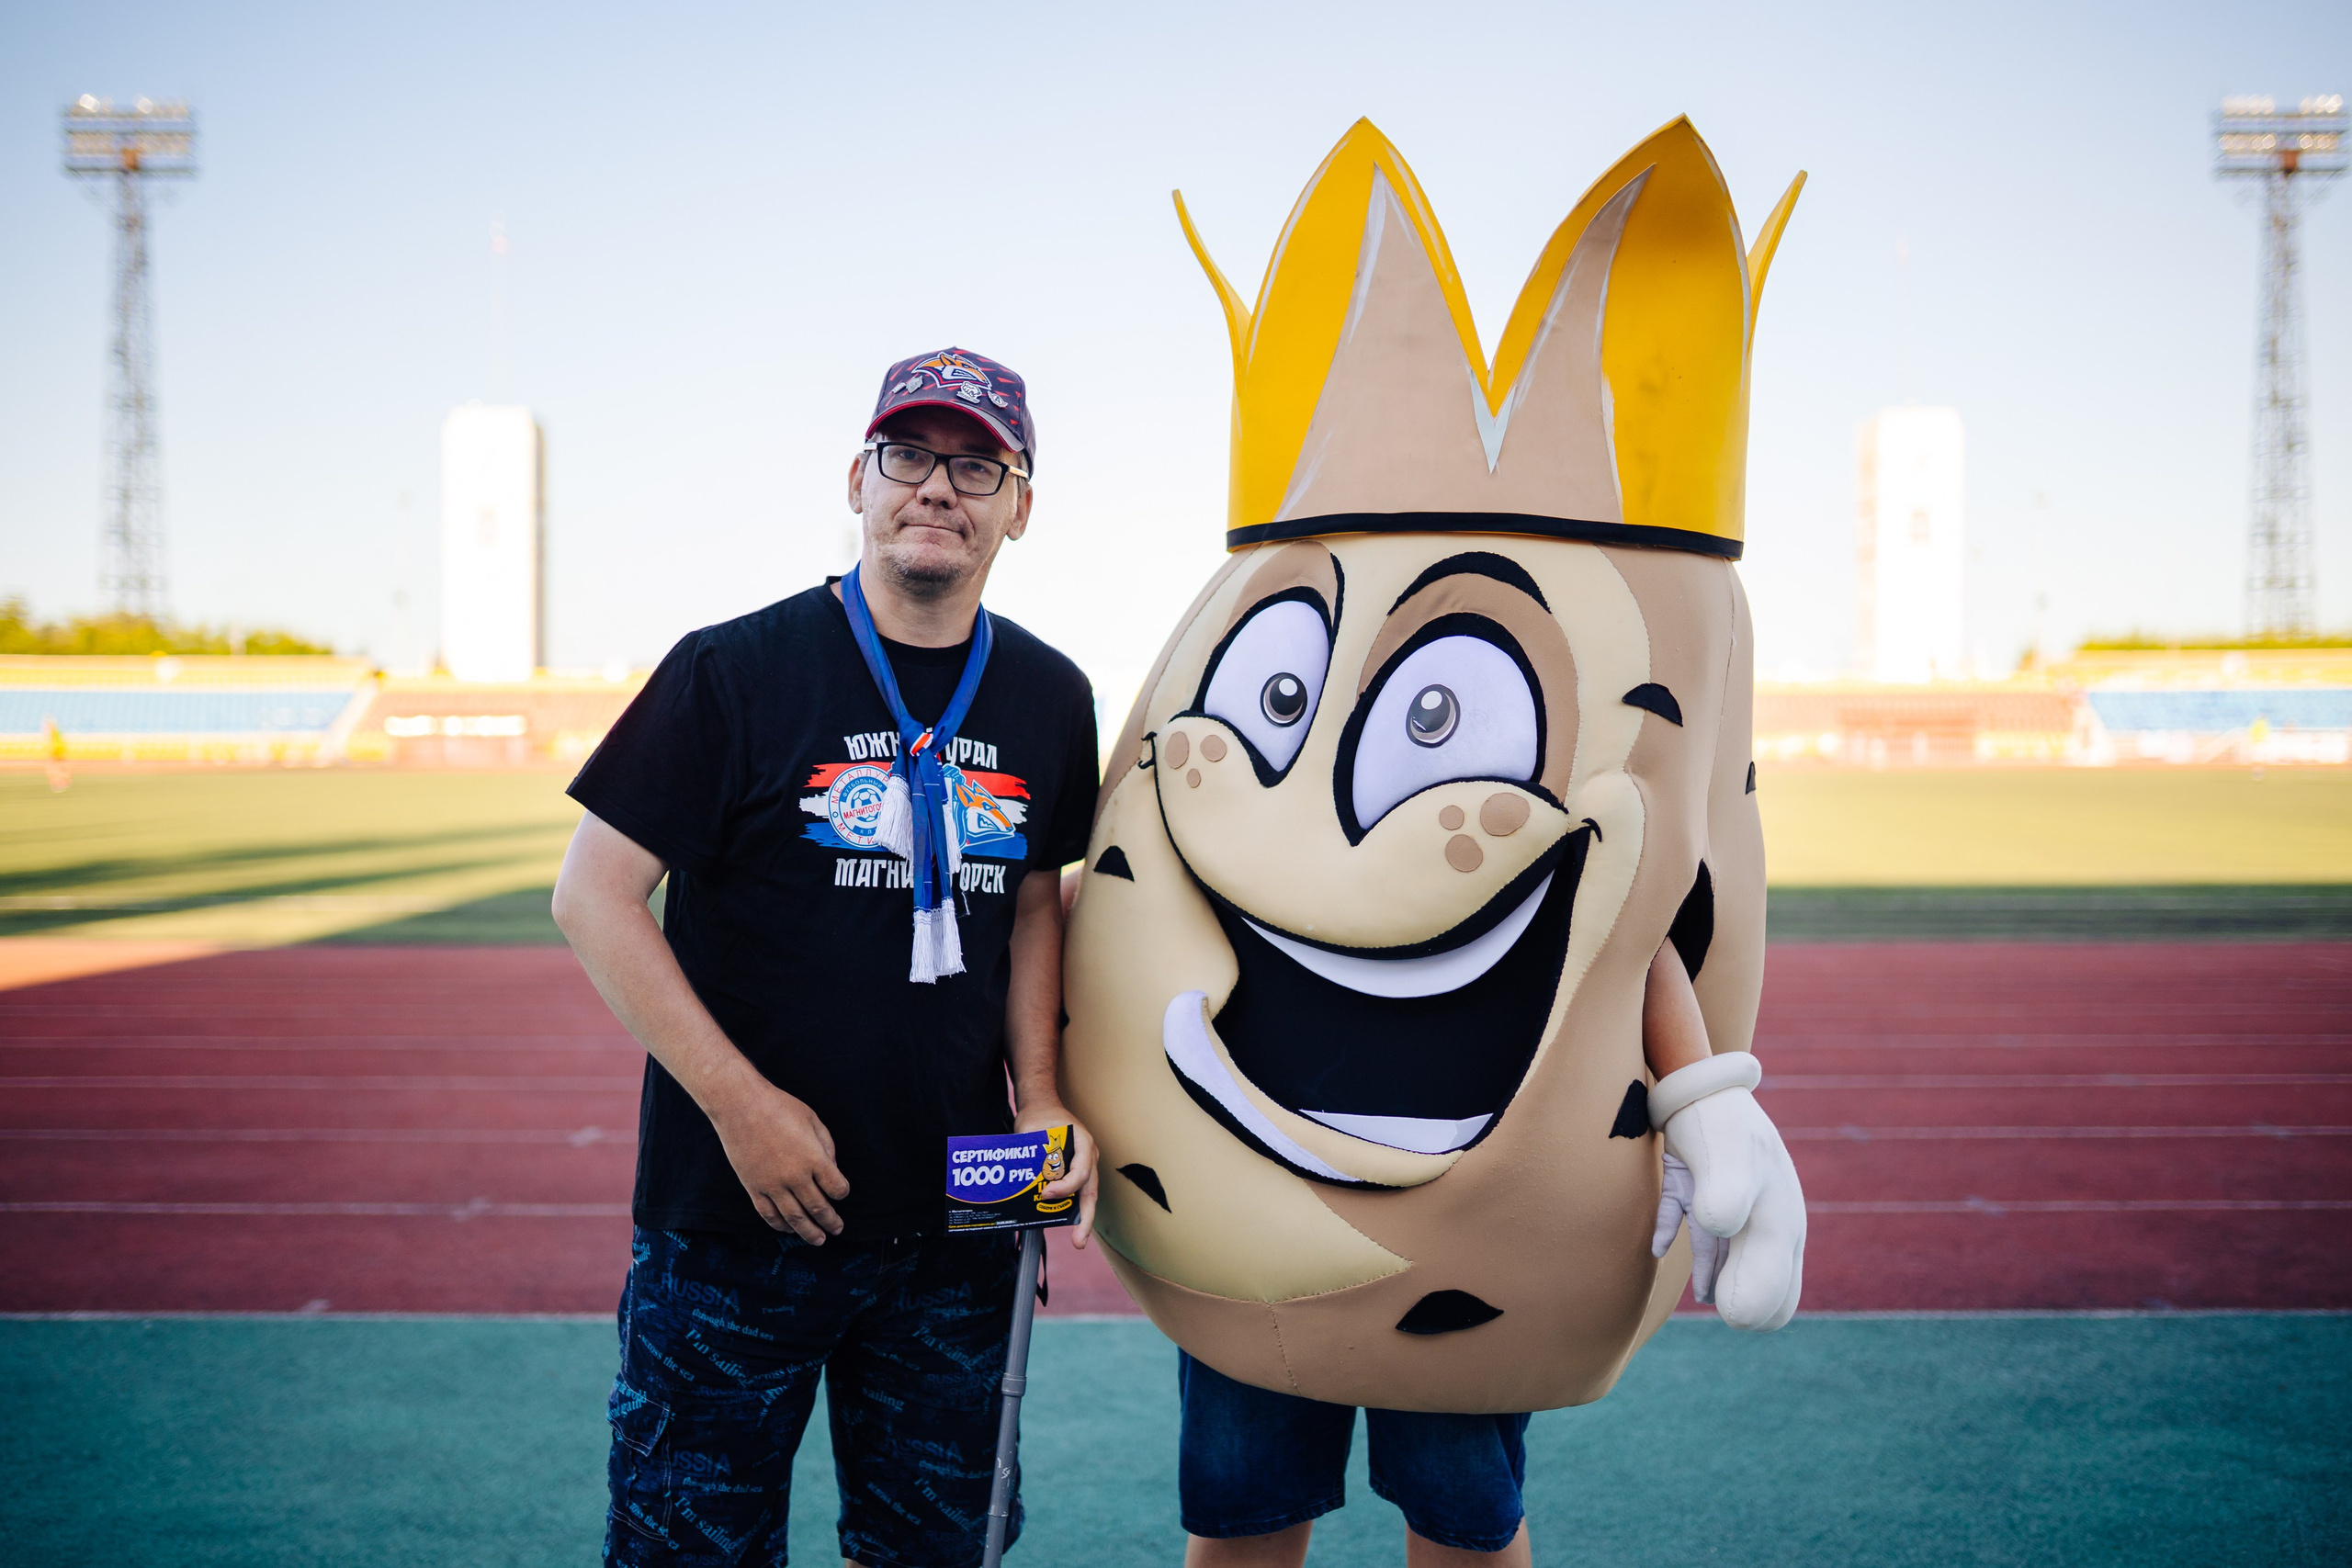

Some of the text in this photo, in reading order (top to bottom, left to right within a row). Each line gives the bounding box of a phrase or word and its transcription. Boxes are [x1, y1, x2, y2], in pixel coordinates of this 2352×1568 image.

[945, 737, 998, 770] УРАЛ
[831, 769, 889, 804] МЕТАЛЛУР
[952, 1145, 1038, 1164] СЕРТИФИКАТ
[952, 1165, 1036, 1186] 1000 РУБ.
[727, 1320, 741, 1332] the
[662, 1354, 679, 1372] the
[677, 1367, 695, 1382] sea
[862, 1386, 905, 1413] sailing
[672, 1450, 732, 1478] USSIA
[673, 1496, 698, 1523] I'm
[695, 1518, 737, 1556] sailing
